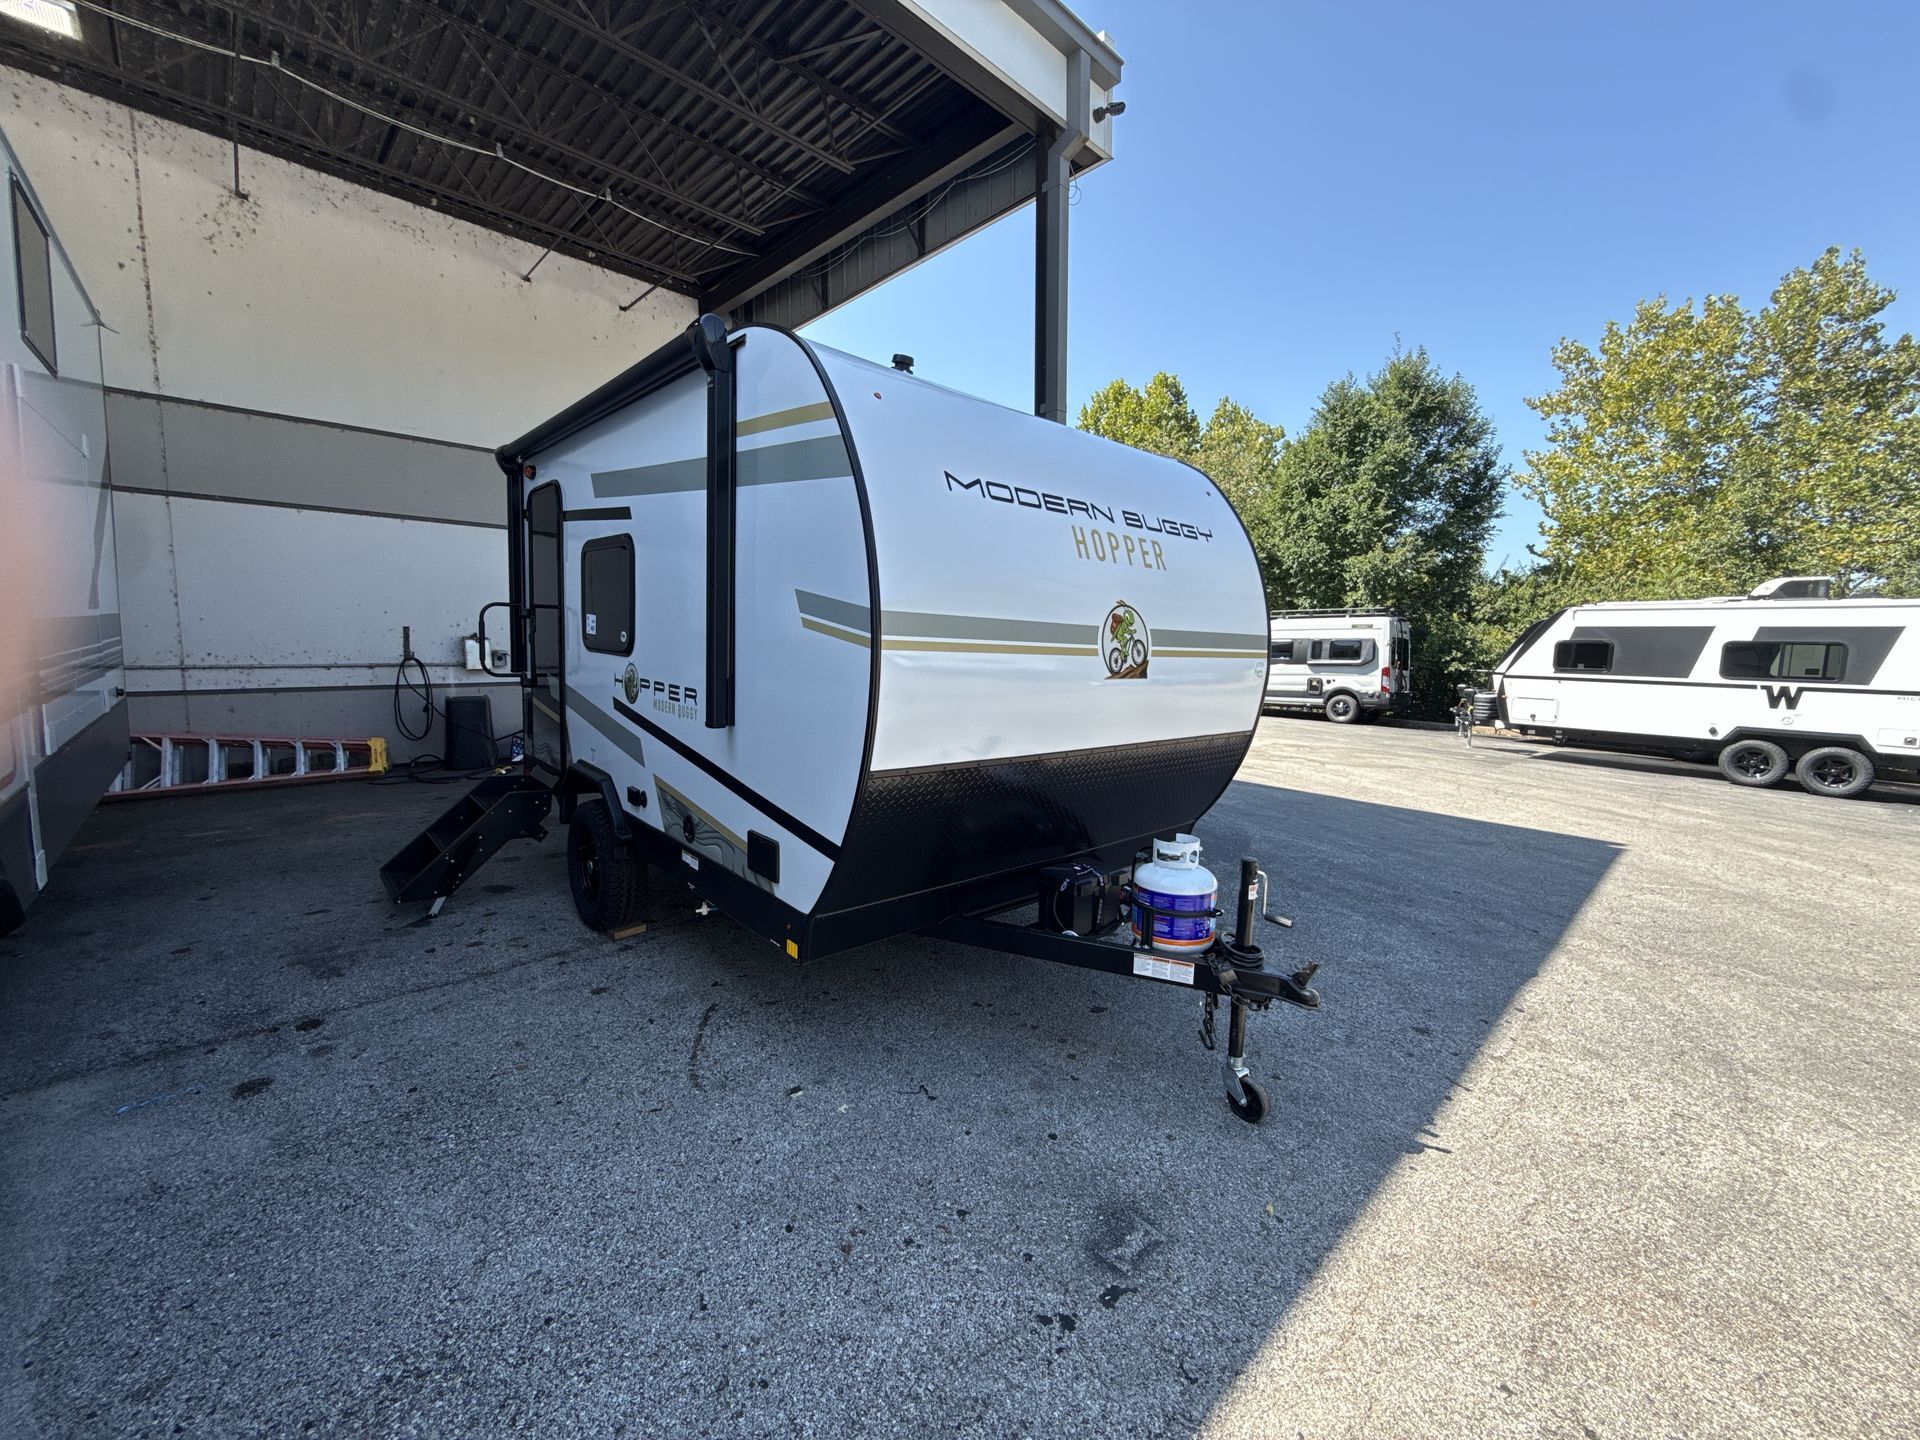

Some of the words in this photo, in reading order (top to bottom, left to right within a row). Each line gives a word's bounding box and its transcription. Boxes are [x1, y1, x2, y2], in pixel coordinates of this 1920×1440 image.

[944, 470, 1115, 524] MODERN
[1122, 511, 1213, 542] BUGGY
[1071, 526, 1167, 570] HOPPER
[653, 699, 675, 715] MODERN
[678, 704, 697, 720] BUGGY
[1760, 685, 1804, 710] W
